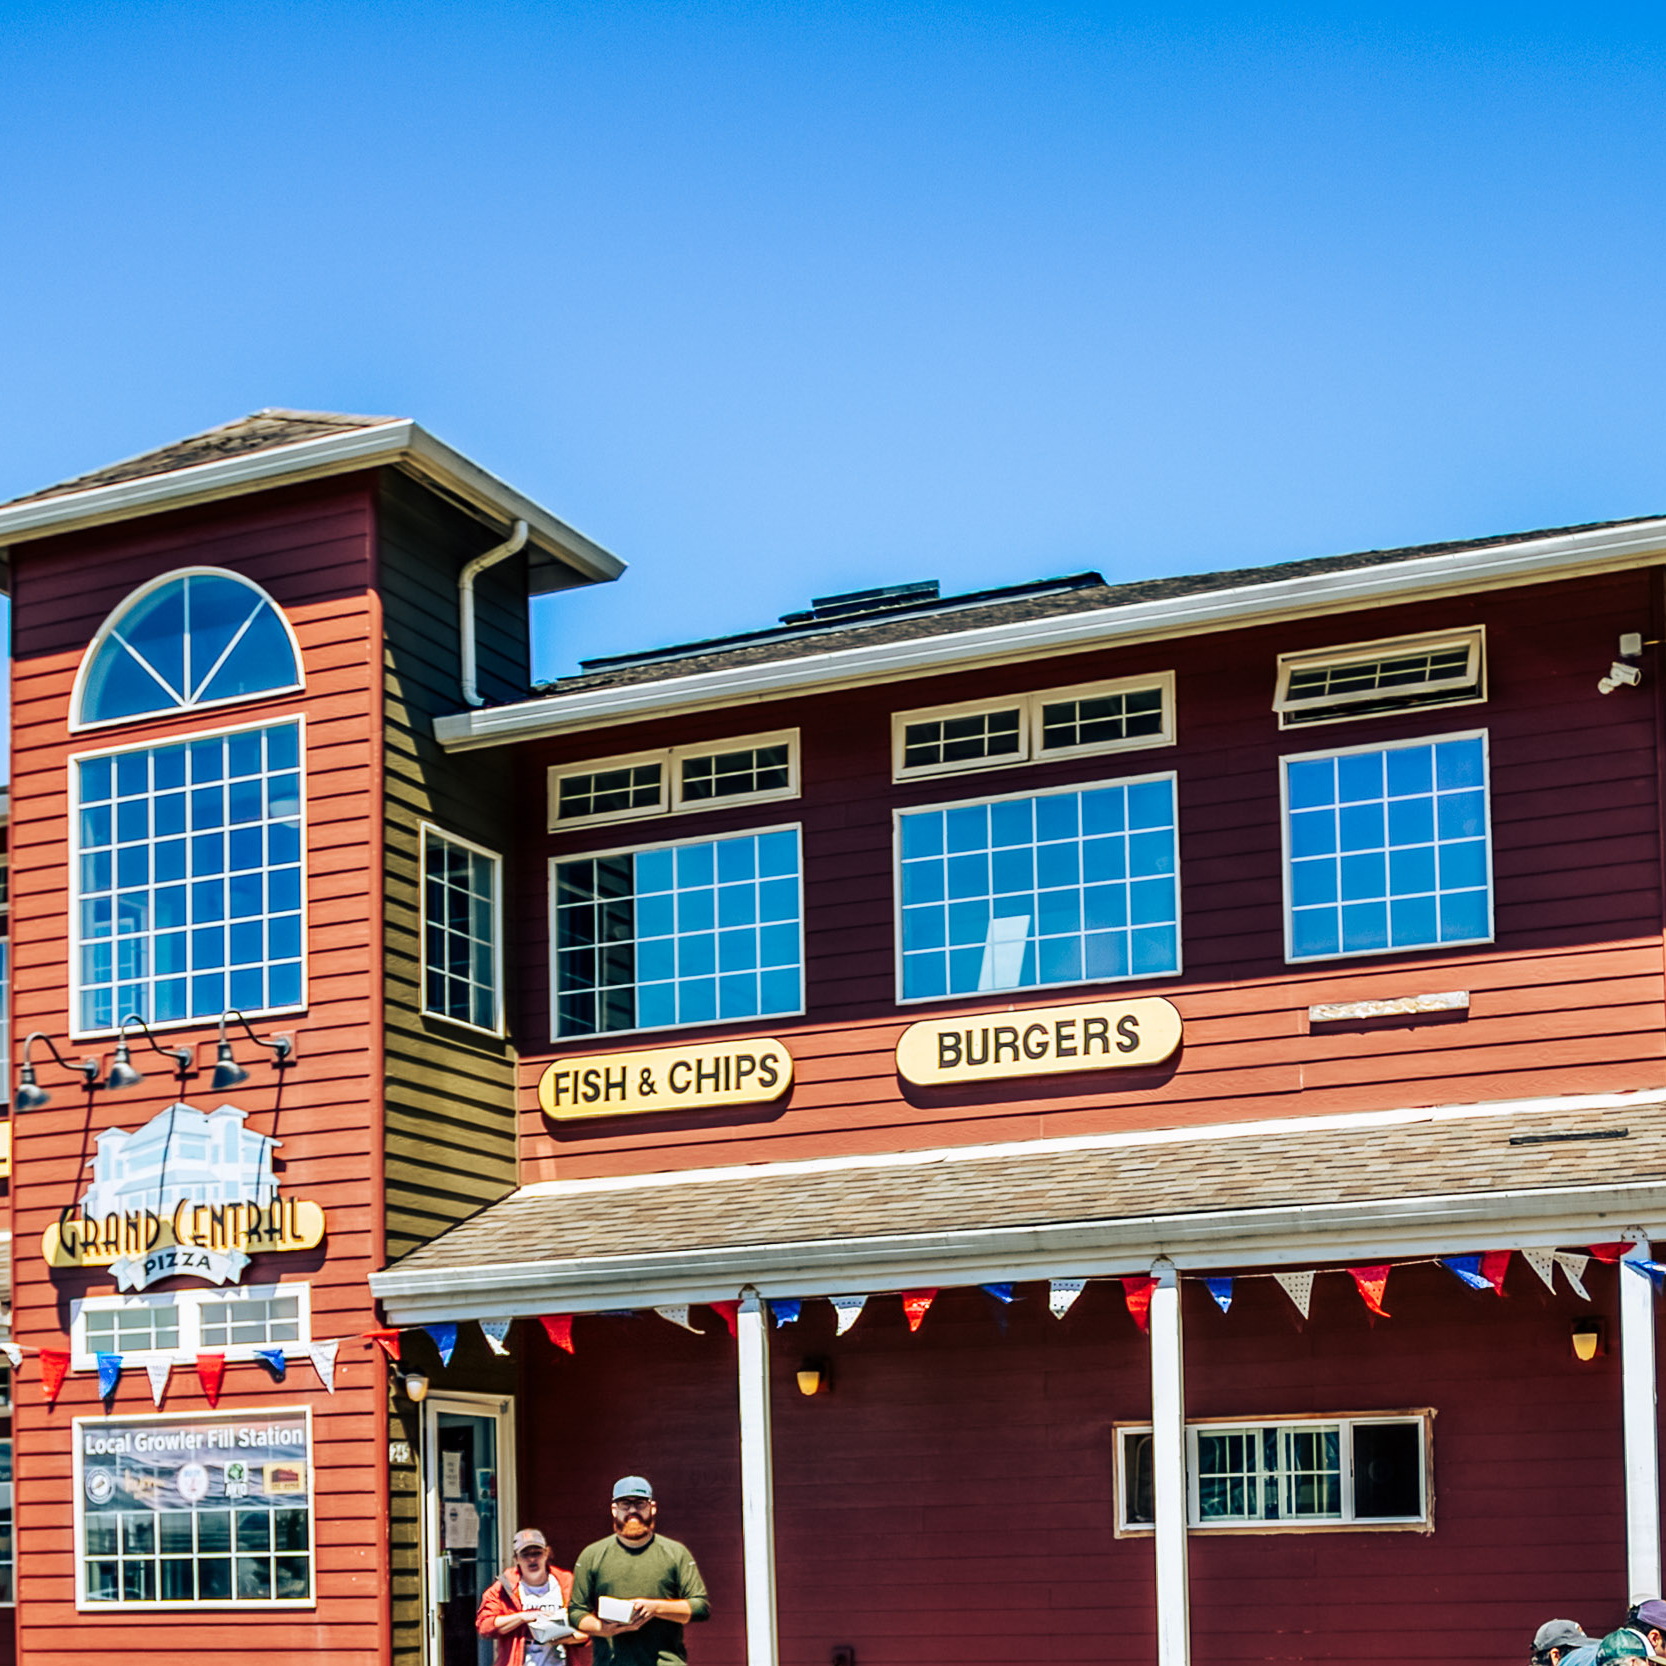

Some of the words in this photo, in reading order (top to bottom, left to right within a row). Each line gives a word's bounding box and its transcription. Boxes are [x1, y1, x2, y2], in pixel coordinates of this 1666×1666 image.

[936, 1014, 1141, 1069] BURGERS
[552, 1064, 628, 1106] FISH
[638, 1068, 659, 1097] &
[668, 1052, 779, 1094] CHIPS
[59, 1202, 161, 1258] GRAND
[173, 1194, 305, 1249] CENTRAL
[144, 1252, 213, 1276] PIZZA
[85, 1432, 132, 1455] Local
[134, 1430, 204, 1453] Growler
[207, 1428, 236, 1449] Fill
[238, 1425, 304, 1448] Station
